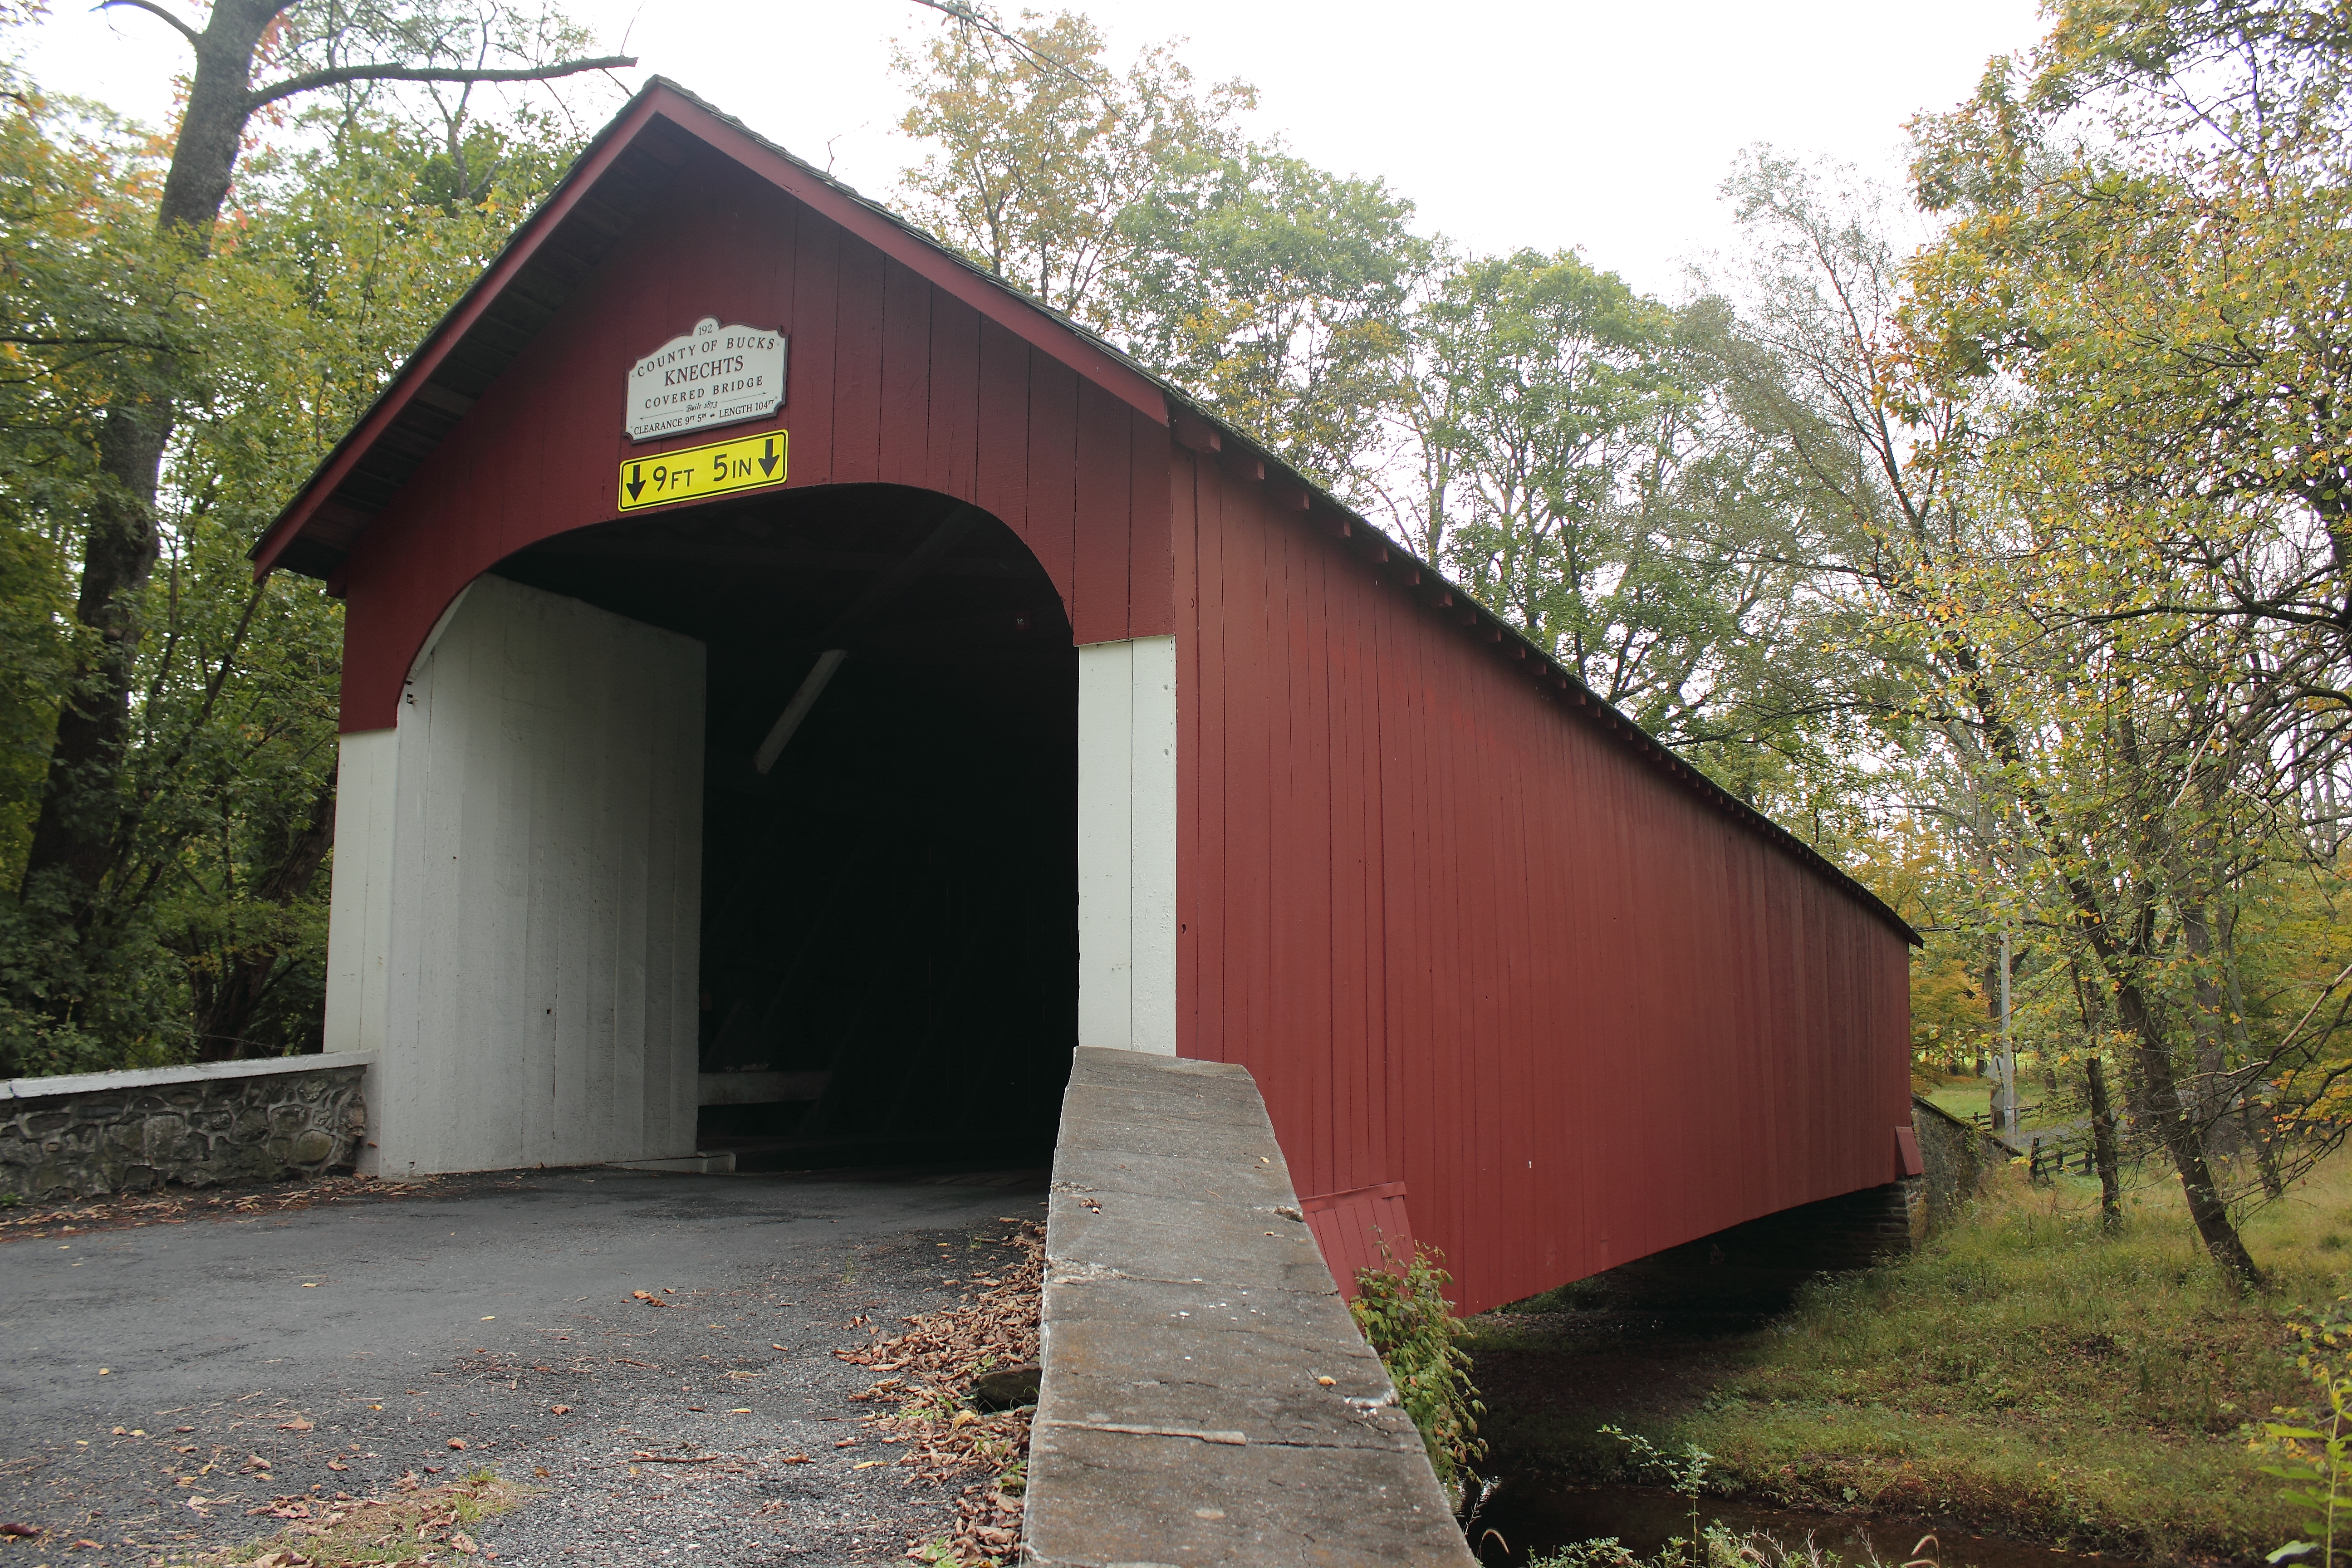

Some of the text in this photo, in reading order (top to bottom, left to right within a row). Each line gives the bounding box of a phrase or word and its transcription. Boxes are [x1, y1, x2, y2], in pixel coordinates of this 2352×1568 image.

[698, 324, 713, 335] 192
[637, 337, 775, 377] COUNTY OF BUCKS
[664, 355, 744, 387] KNECHTS
[645, 376, 764, 409] COVERED BRIDGE
[686, 401, 718, 412] Built 1873
[634, 399, 774, 435] CLEARANCE 9FT 5IN LENGTH 104FT
